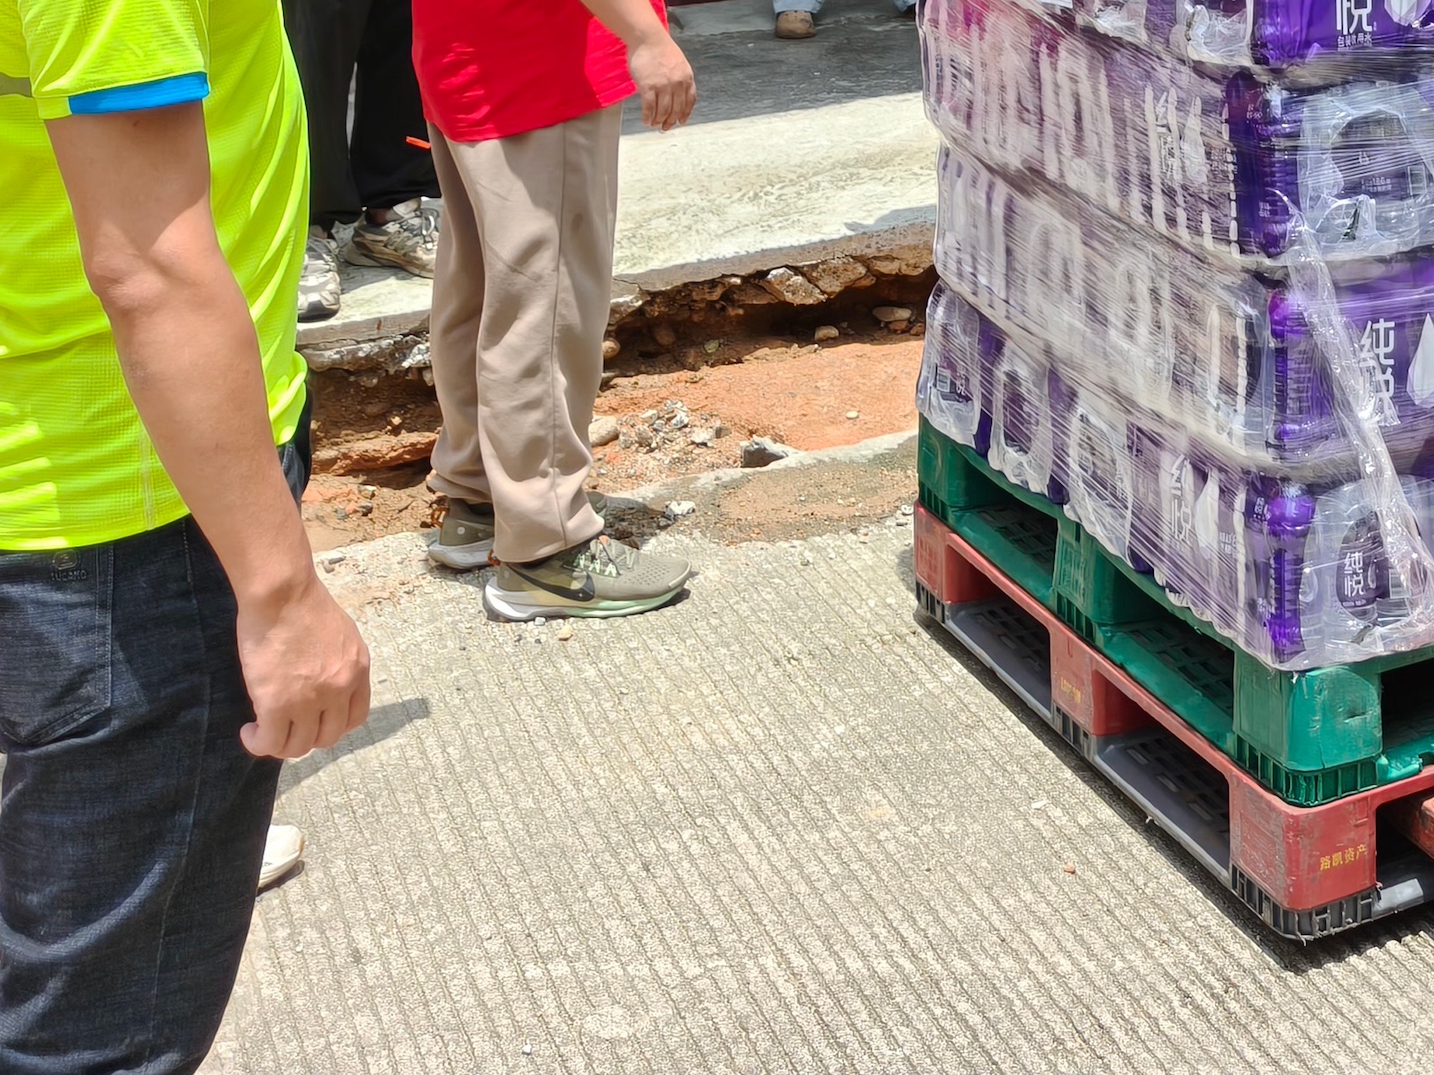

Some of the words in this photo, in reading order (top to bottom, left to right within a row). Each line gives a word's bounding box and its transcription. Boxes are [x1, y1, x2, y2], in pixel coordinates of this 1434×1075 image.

[1344, 552, 1366, 598] 纯悦
[1319, 844, 1367, 871] 路凯资产
